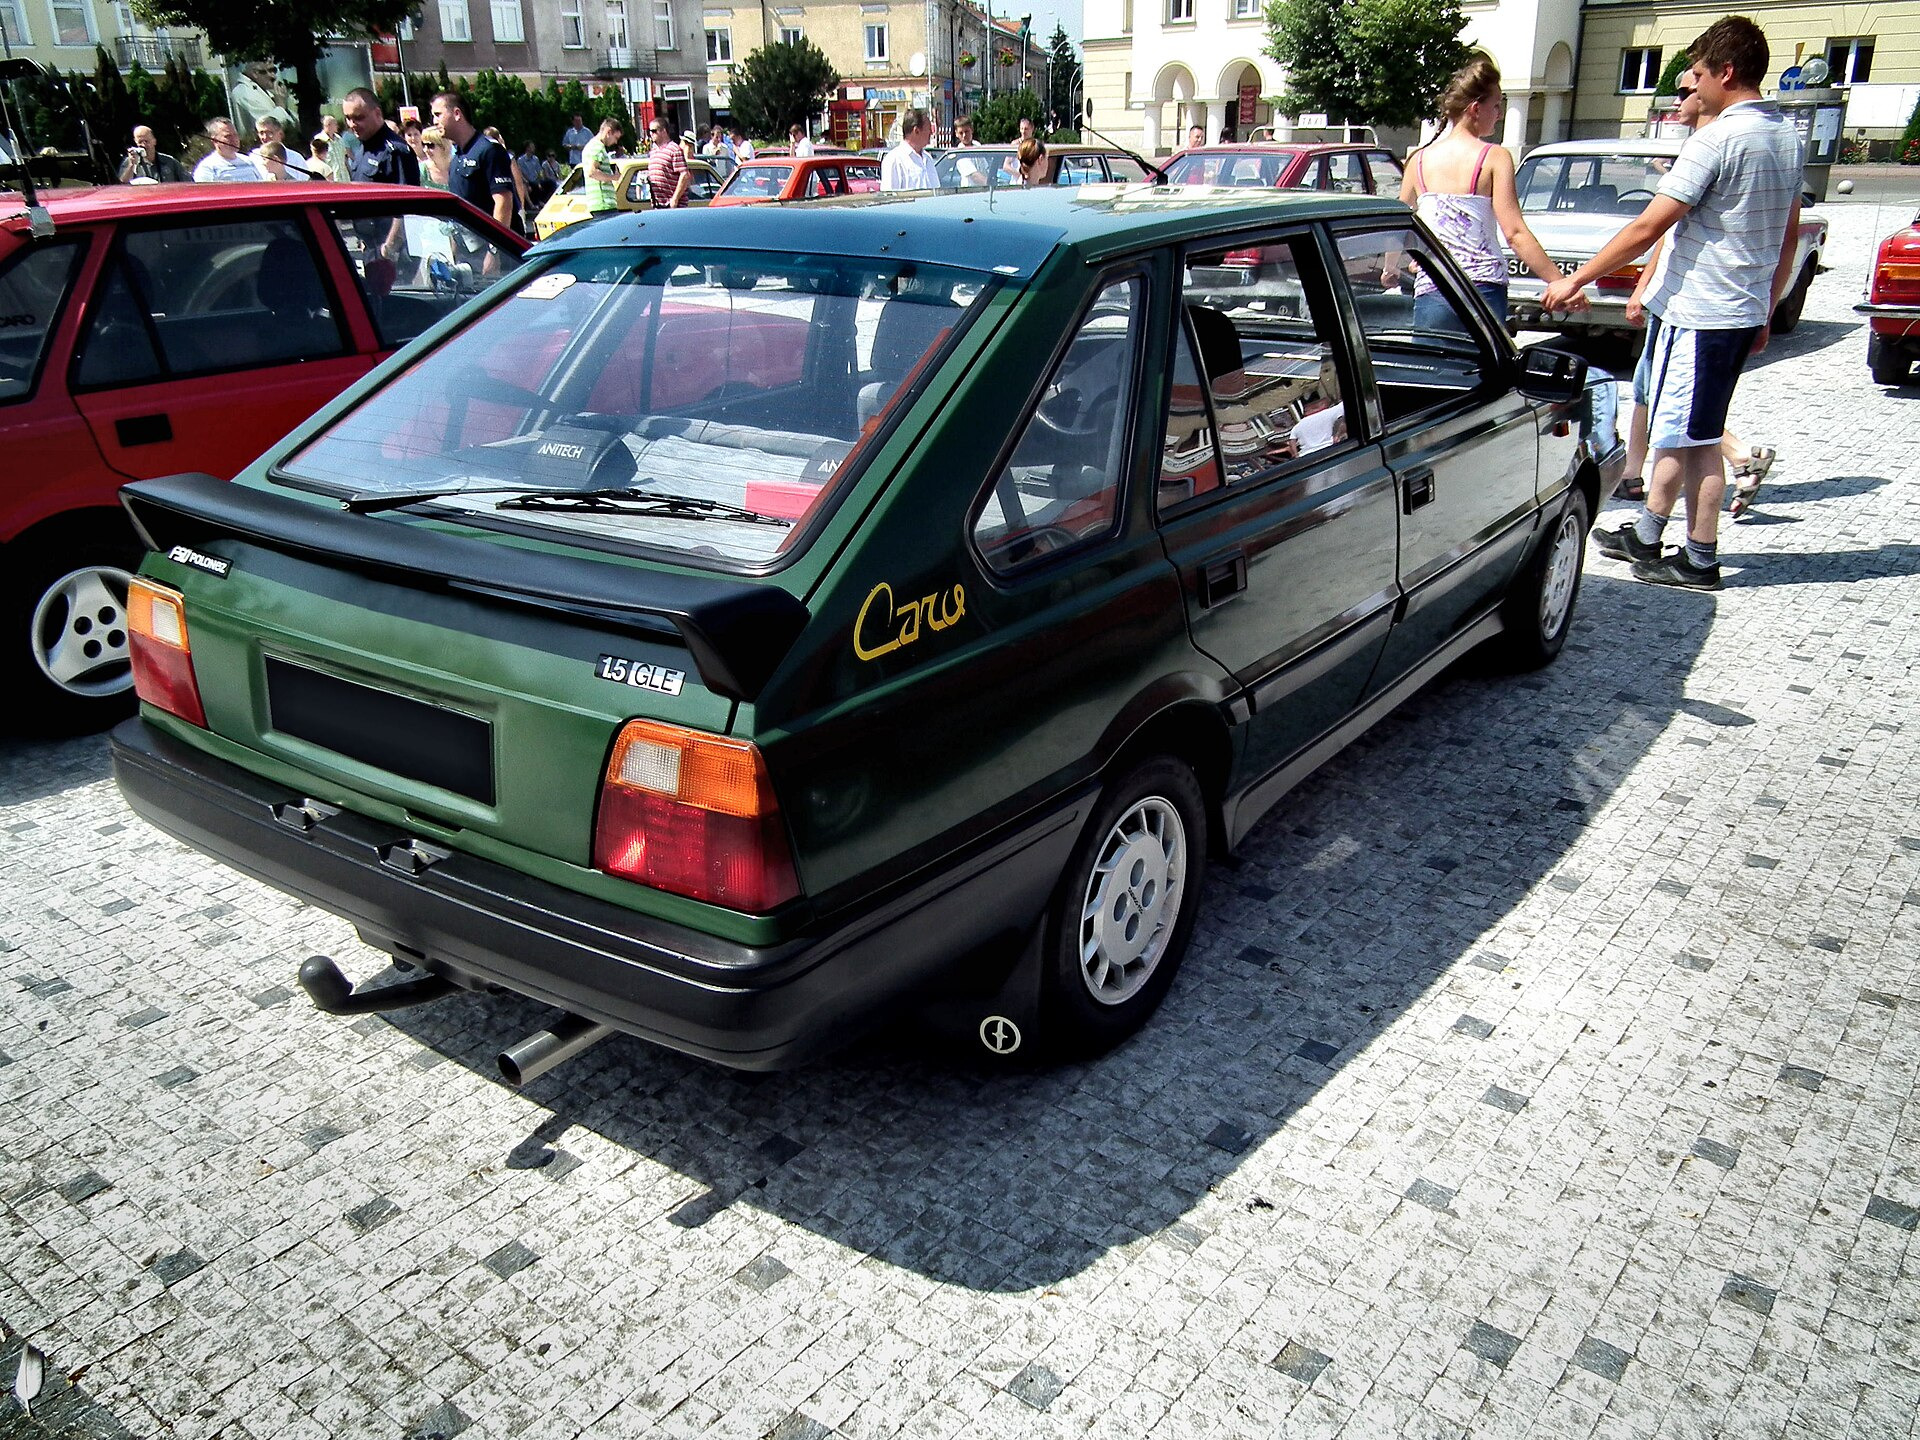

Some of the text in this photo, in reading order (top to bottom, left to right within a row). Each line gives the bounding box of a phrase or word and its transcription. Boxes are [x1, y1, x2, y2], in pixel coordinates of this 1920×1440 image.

[537, 442, 585, 459] ANITECH
[168, 545, 228, 574] FSO POLONEZ
[853, 581, 966, 661] Caro
[634, 663, 678, 692] GLE
